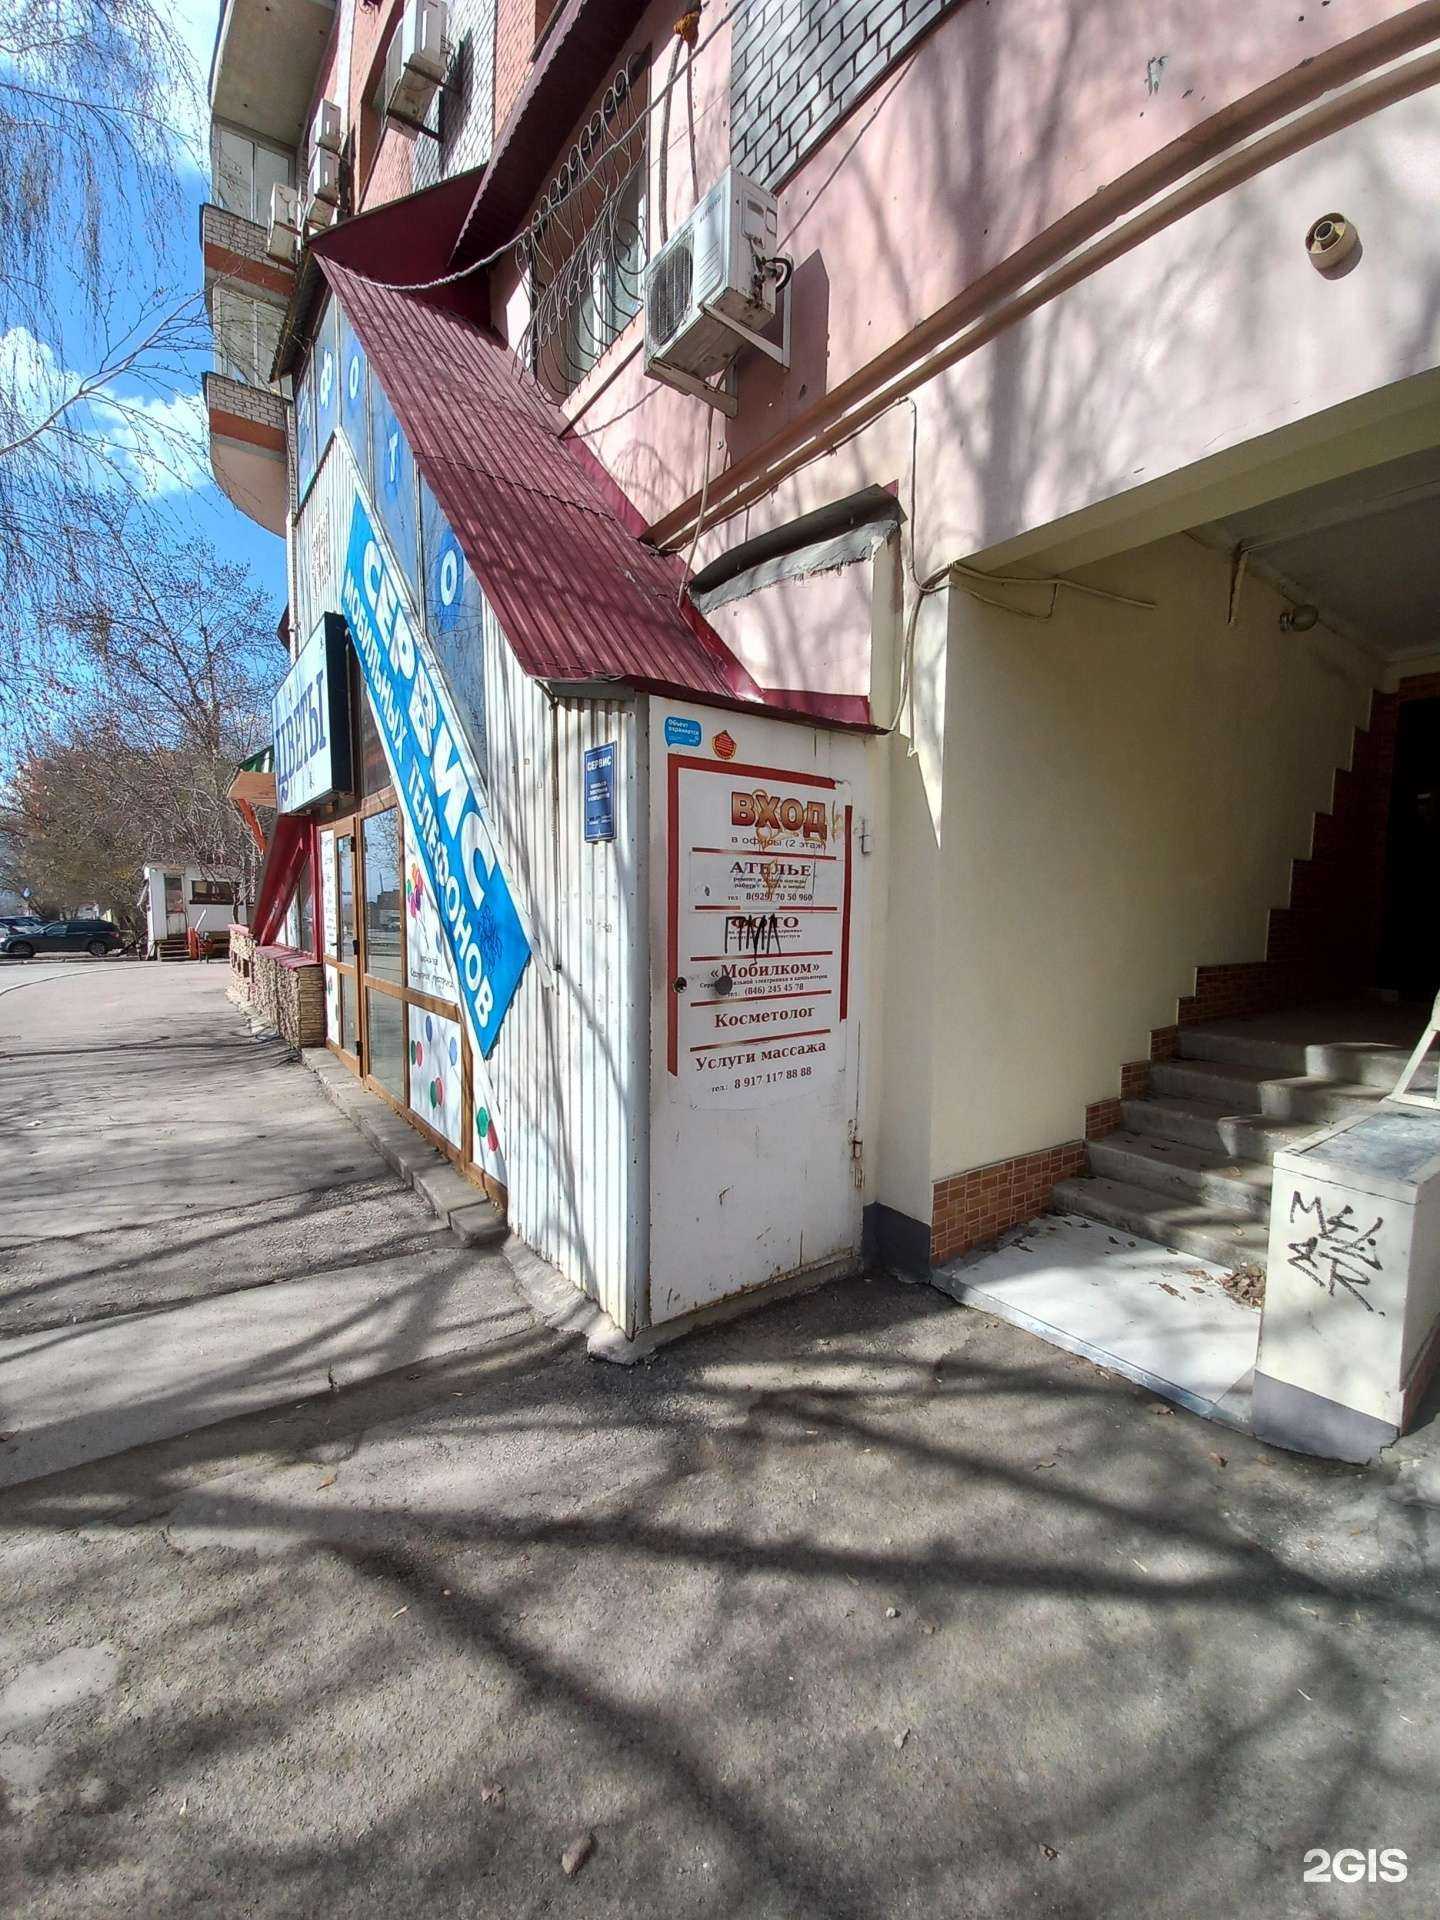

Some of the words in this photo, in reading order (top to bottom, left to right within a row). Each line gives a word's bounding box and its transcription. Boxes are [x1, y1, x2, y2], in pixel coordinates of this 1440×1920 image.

[363, 539, 497, 910] СЕРВИС
[275, 670, 327, 802] ЦВЕТЫ
[587, 755, 612, 772] СЕРВИС
[341, 568, 408, 764] МОБИЛЬНЫХ
[404, 755, 494, 1028] ТЕЛЕФОНОВ
[731, 791, 827, 841] ВХОД
[785, 839, 796, 849] (2
[787, 893, 797, 901] 50
[799, 893, 813, 902] 960
[710, 963, 820, 979] «Мобилком»
[745, 986, 765, 996] (846)
[768, 984, 782, 994] 245
[784, 983, 794, 992] 45
[795, 982, 804, 991] 78
[714, 1007, 816, 1029] Косметолог
[696, 1053, 756, 1071] Услуги
[761, 1042, 827, 1061] массажа
[734, 1079, 741, 1089] 8
[744, 1075, 763, 1087] 917
[766, 1071, 783, 1083] 117
[786, 1069, 798, 1079] 88
[800, 1066, 812, 1077] 88
